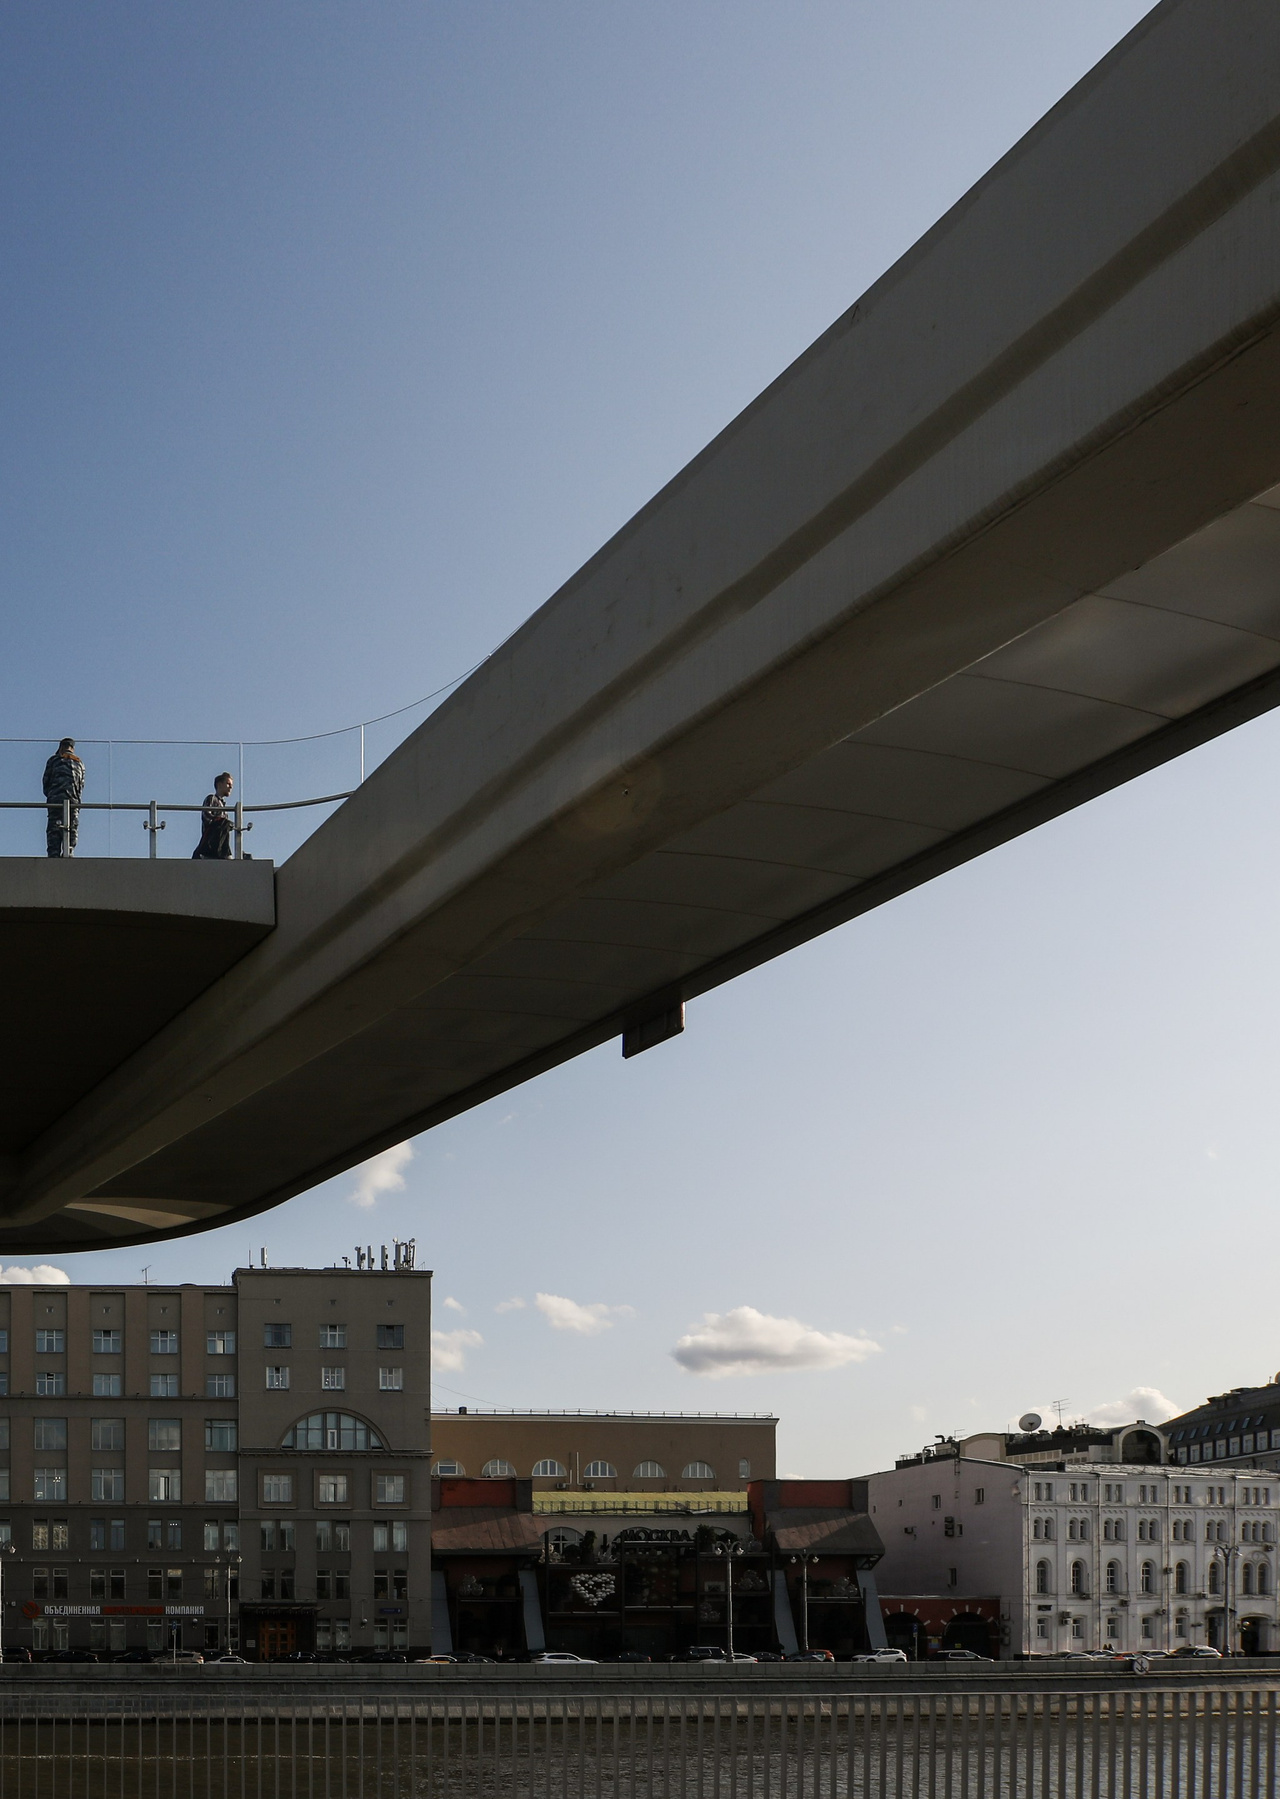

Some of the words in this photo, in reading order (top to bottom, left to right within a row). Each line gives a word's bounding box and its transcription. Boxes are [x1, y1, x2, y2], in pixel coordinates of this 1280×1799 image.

[622, 1529, 692, 1541] МОСКВА
[44, 1605, 101, 1616] ОБЪЕДИНЕННАЯ
[165, 1605, 204, 1615] КОМПАНИЯ
